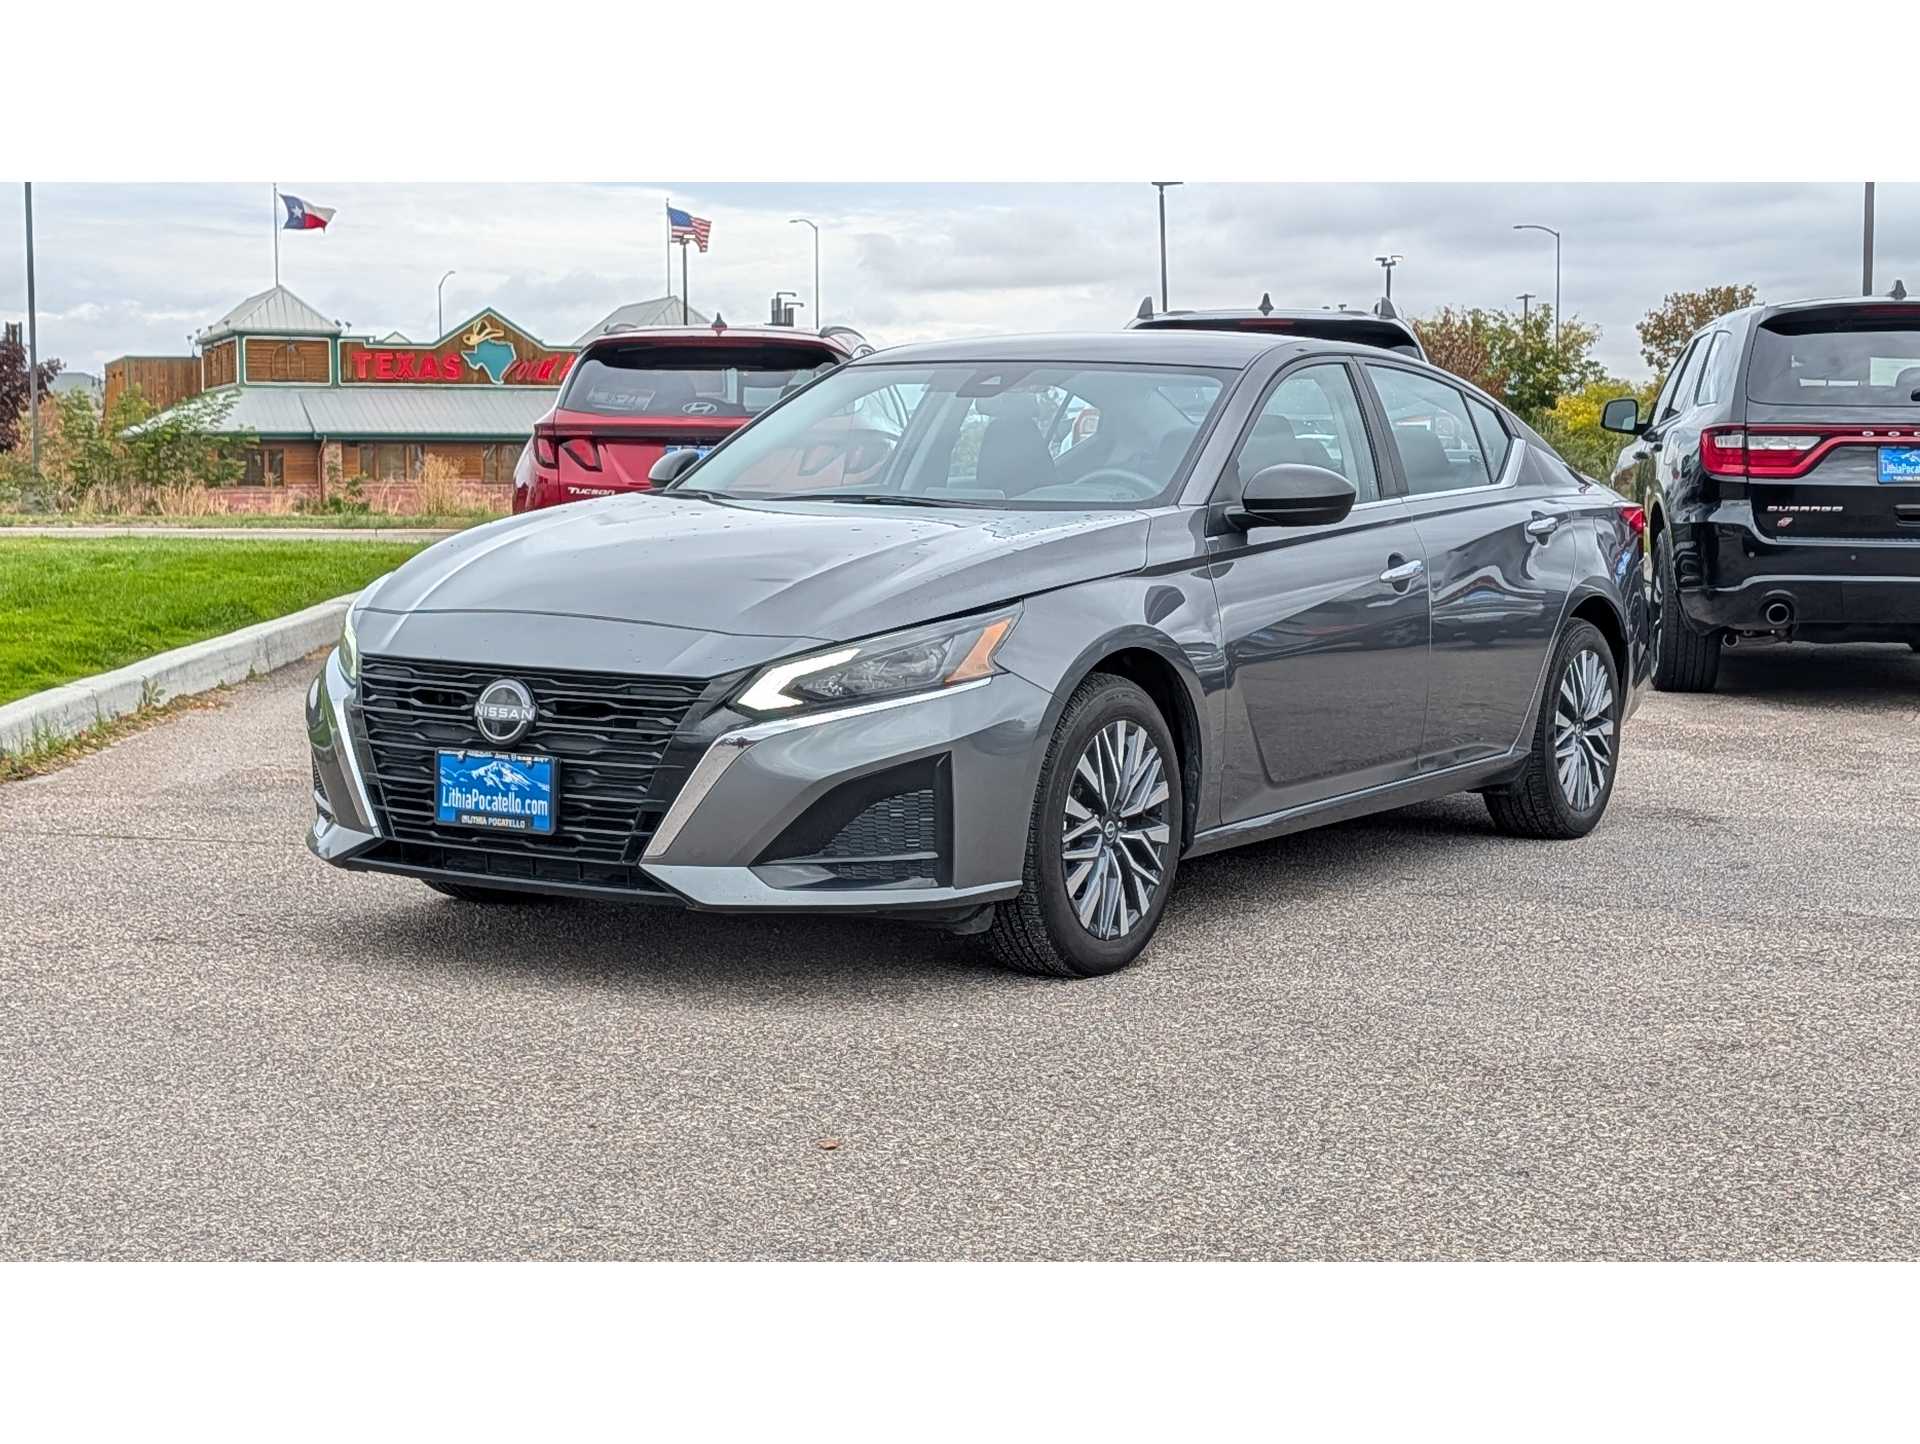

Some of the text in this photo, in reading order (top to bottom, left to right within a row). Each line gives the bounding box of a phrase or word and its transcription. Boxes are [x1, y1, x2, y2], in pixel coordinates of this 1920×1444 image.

[352, 352, 464, 380] TEXAS
[474, 704, 534, 720] NISSAN
[442, 785, 548, 816] LithiaPocatello.com
[488, 816, 526, 829] POCATELLO
